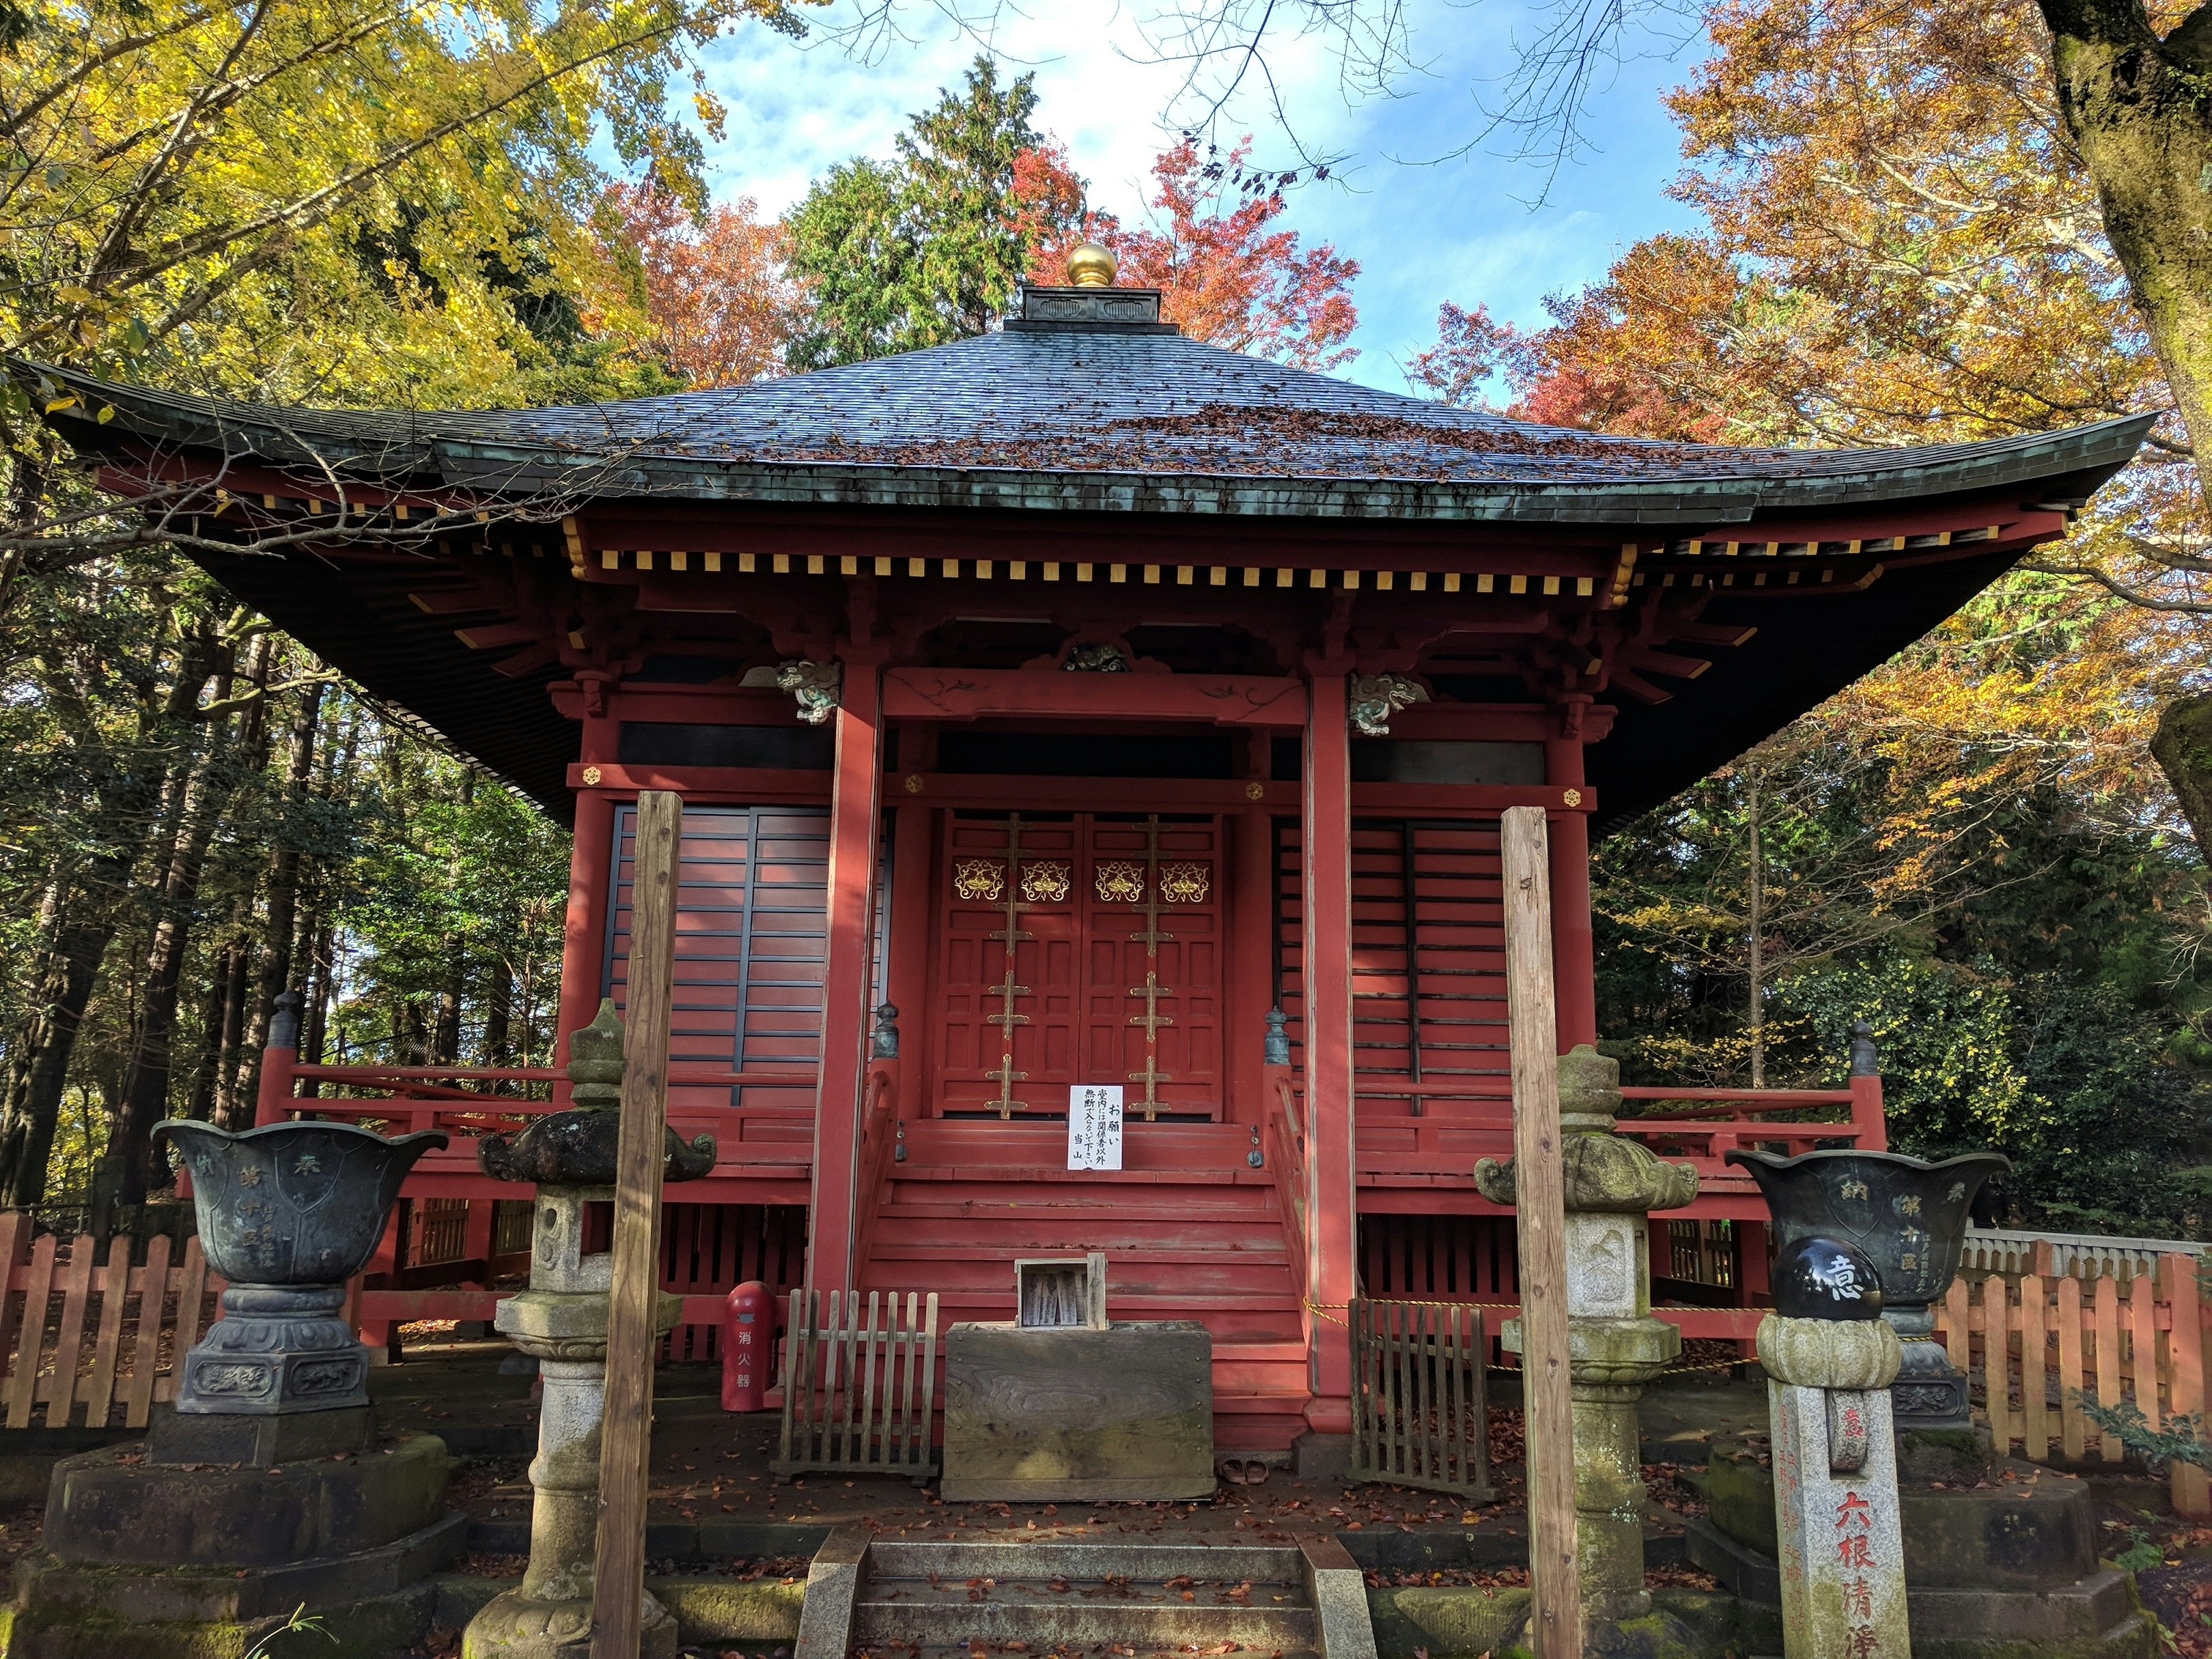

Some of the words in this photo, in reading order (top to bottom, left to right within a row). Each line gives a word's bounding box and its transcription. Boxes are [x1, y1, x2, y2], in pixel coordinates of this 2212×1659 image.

[1084, 1089, 1096, 1165] 無断で入らないで下さい
[1095, 1089, 1108, 1165] 堂内には関係者以外
[1107, 1104, 1120, 1145] お願い
[1073, 1134, 1082, 1160] 当山
[1841, 1180, 1868, 1202] 納
[1825, 1255, 1864, 1301] 意
[737, 1332, 751, 1387] 消火器
[1843, 1408, 1864, 1437] 意
